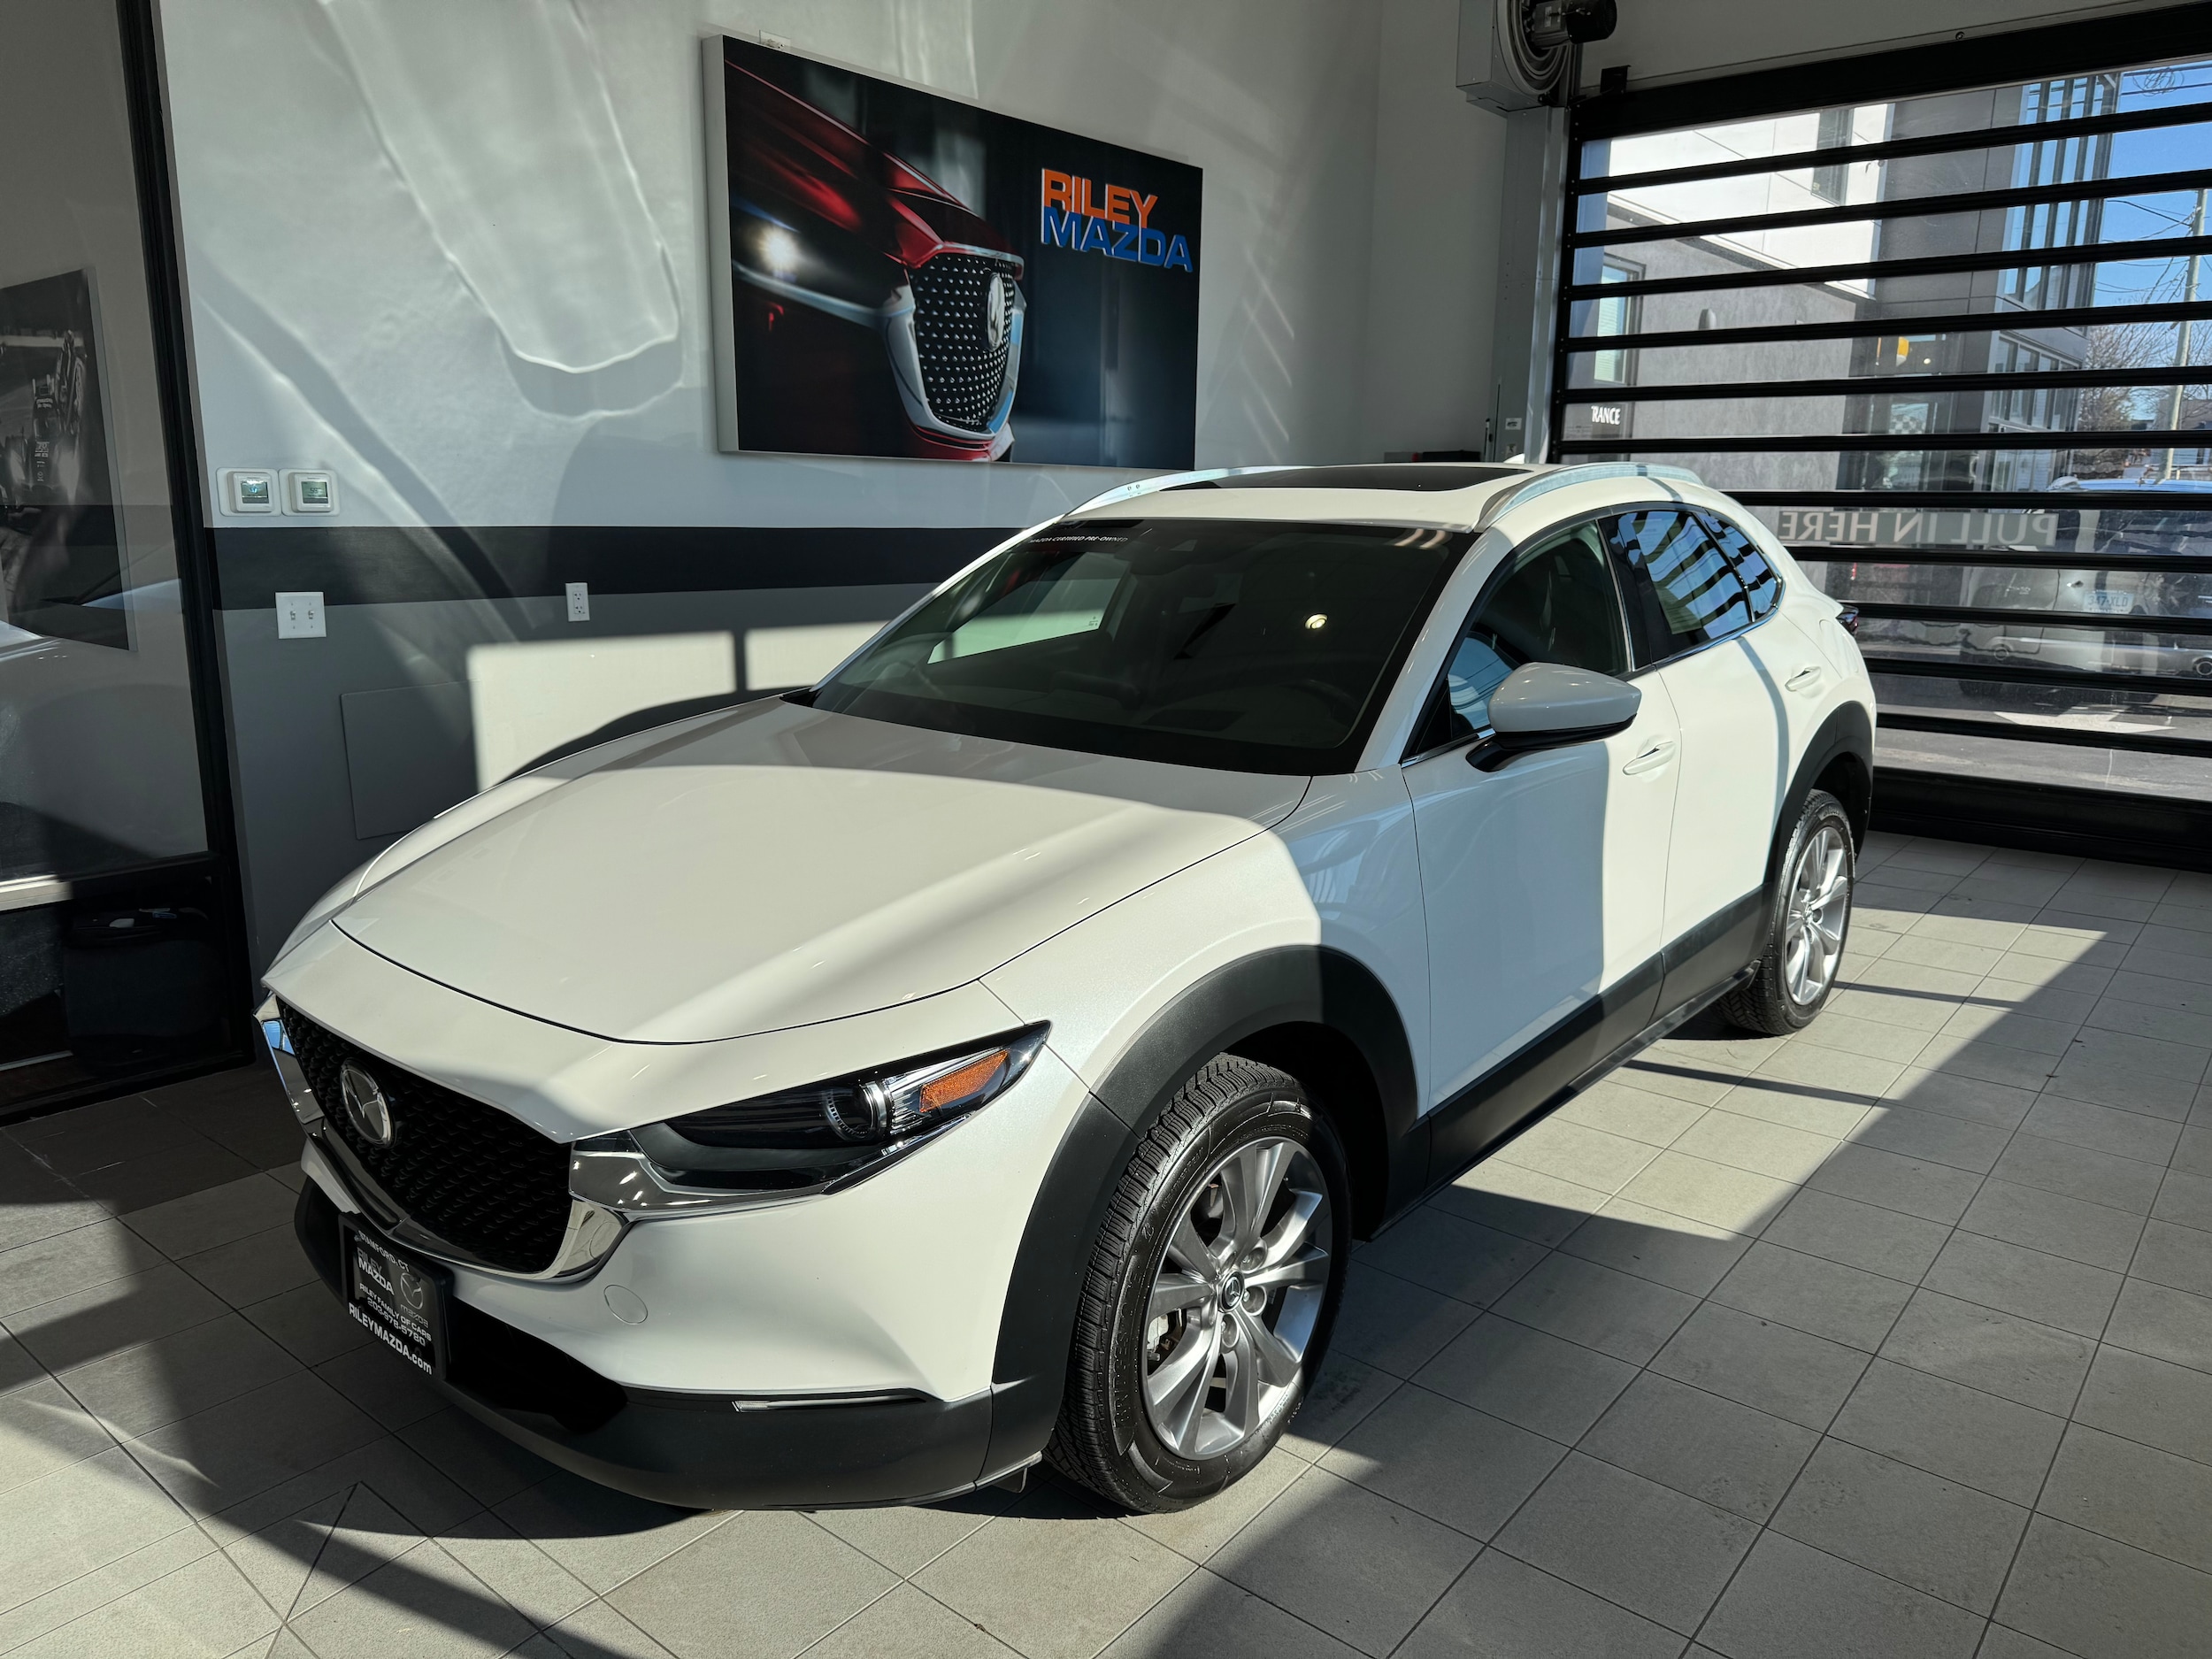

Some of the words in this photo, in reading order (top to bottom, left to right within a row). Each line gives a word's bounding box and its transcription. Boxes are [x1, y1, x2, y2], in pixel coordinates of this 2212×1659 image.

[1041, 168, 1158, 228] RILEY
[1041, 205, 1194, 273] MAZDA
[357, 1246, 382, 1274] RILEY
[358, 1256, 396, 1296] MAZDA
[397, 1259, 410, 1272] CT
[349, 1302, 433, 1375] RILEYMAZDA.com
[359, 1282, 377, 1300] RILEY
[377, 1296, 400, 1319] FAMILY
[400, 1315, 412, 1326] OF
[411, 1322, 432, 1341] CARS
